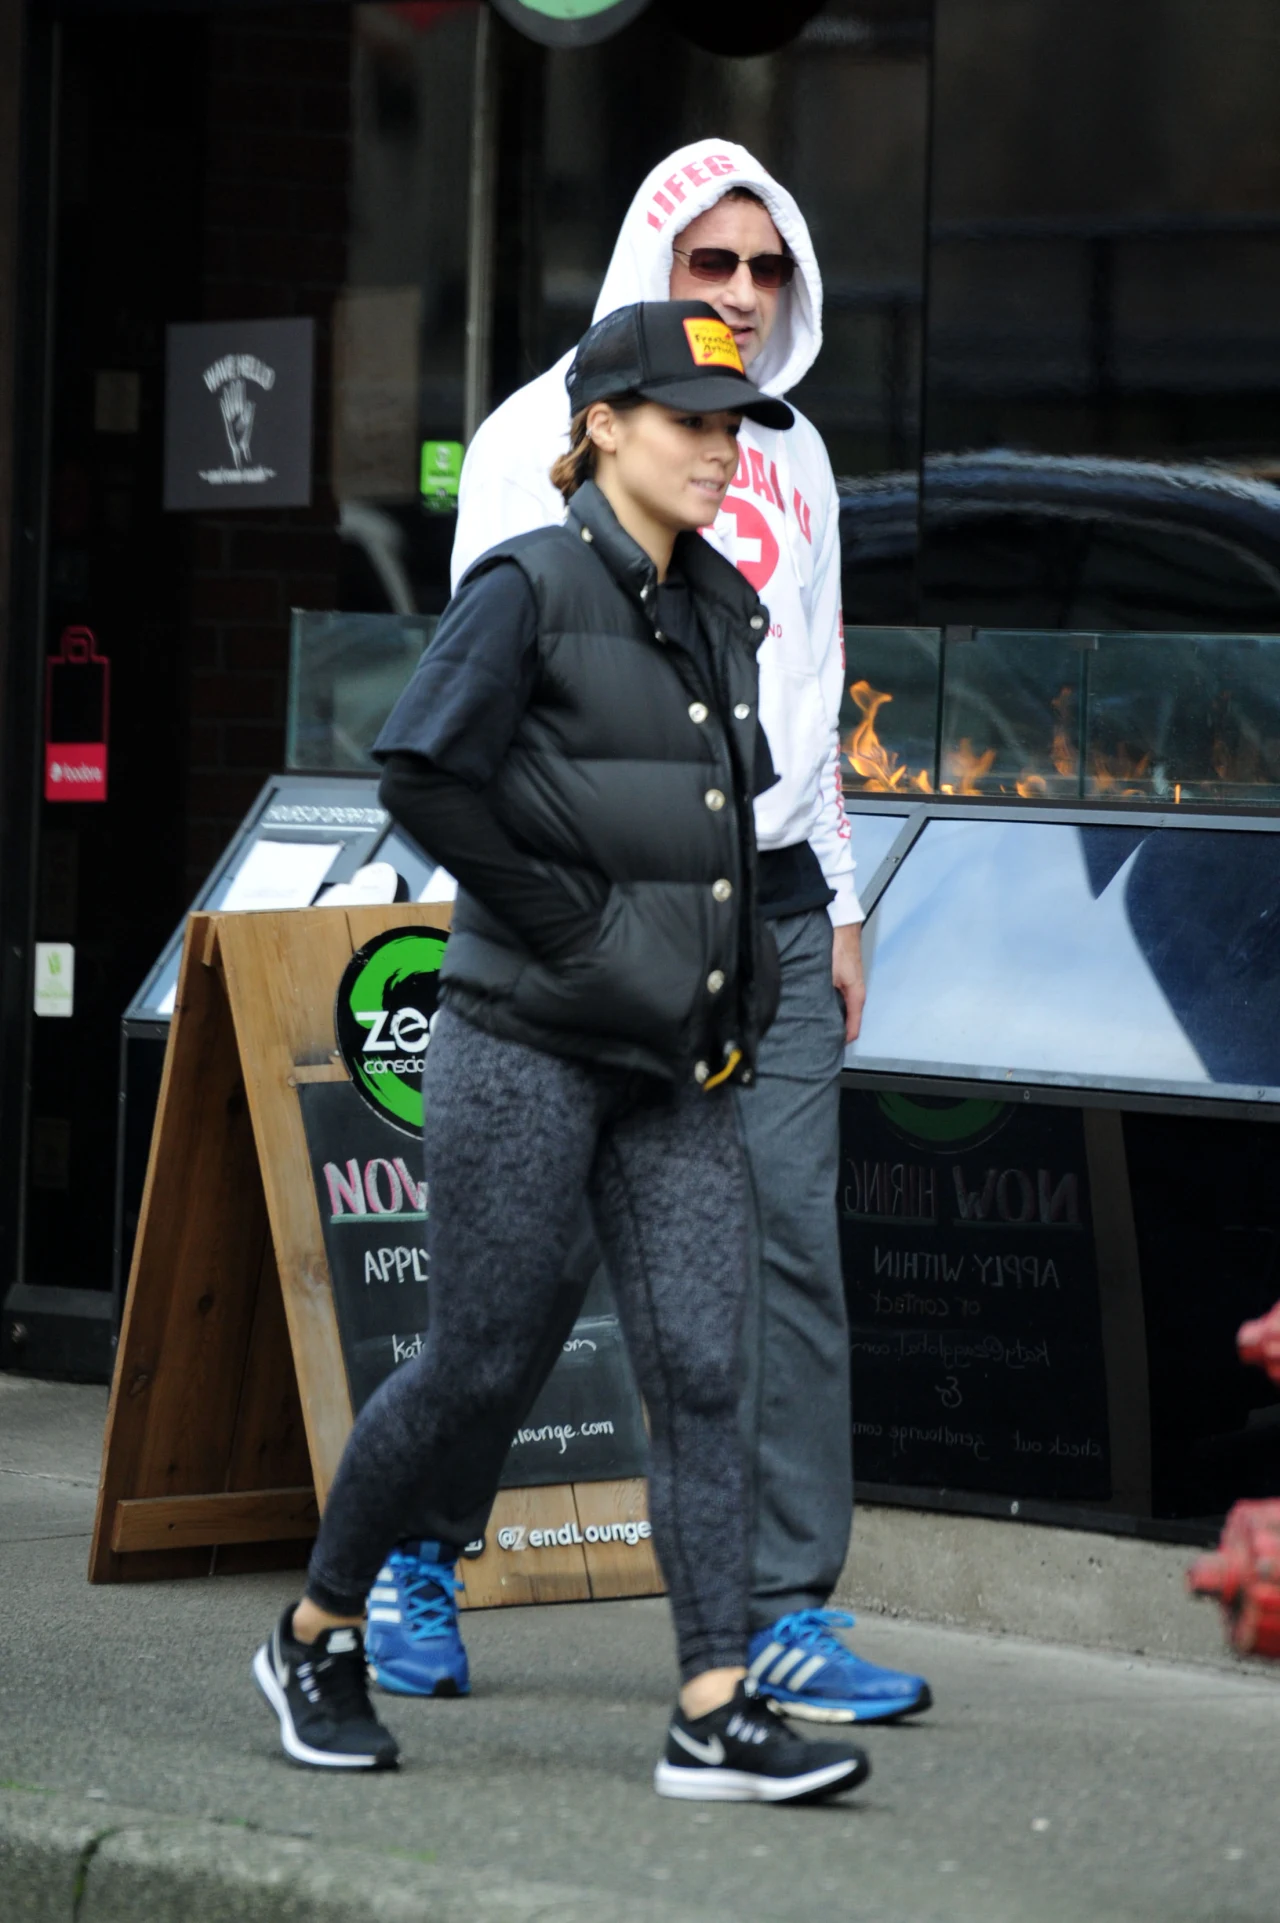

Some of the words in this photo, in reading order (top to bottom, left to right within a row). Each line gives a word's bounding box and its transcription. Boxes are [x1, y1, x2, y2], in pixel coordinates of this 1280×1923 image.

[646, 154, 740, 233] LIFEG
[355, 1006, 440, 1053] ze
[363, 1055, 427, 1075] conscio
[391, 1333, 426, 1363] kat
